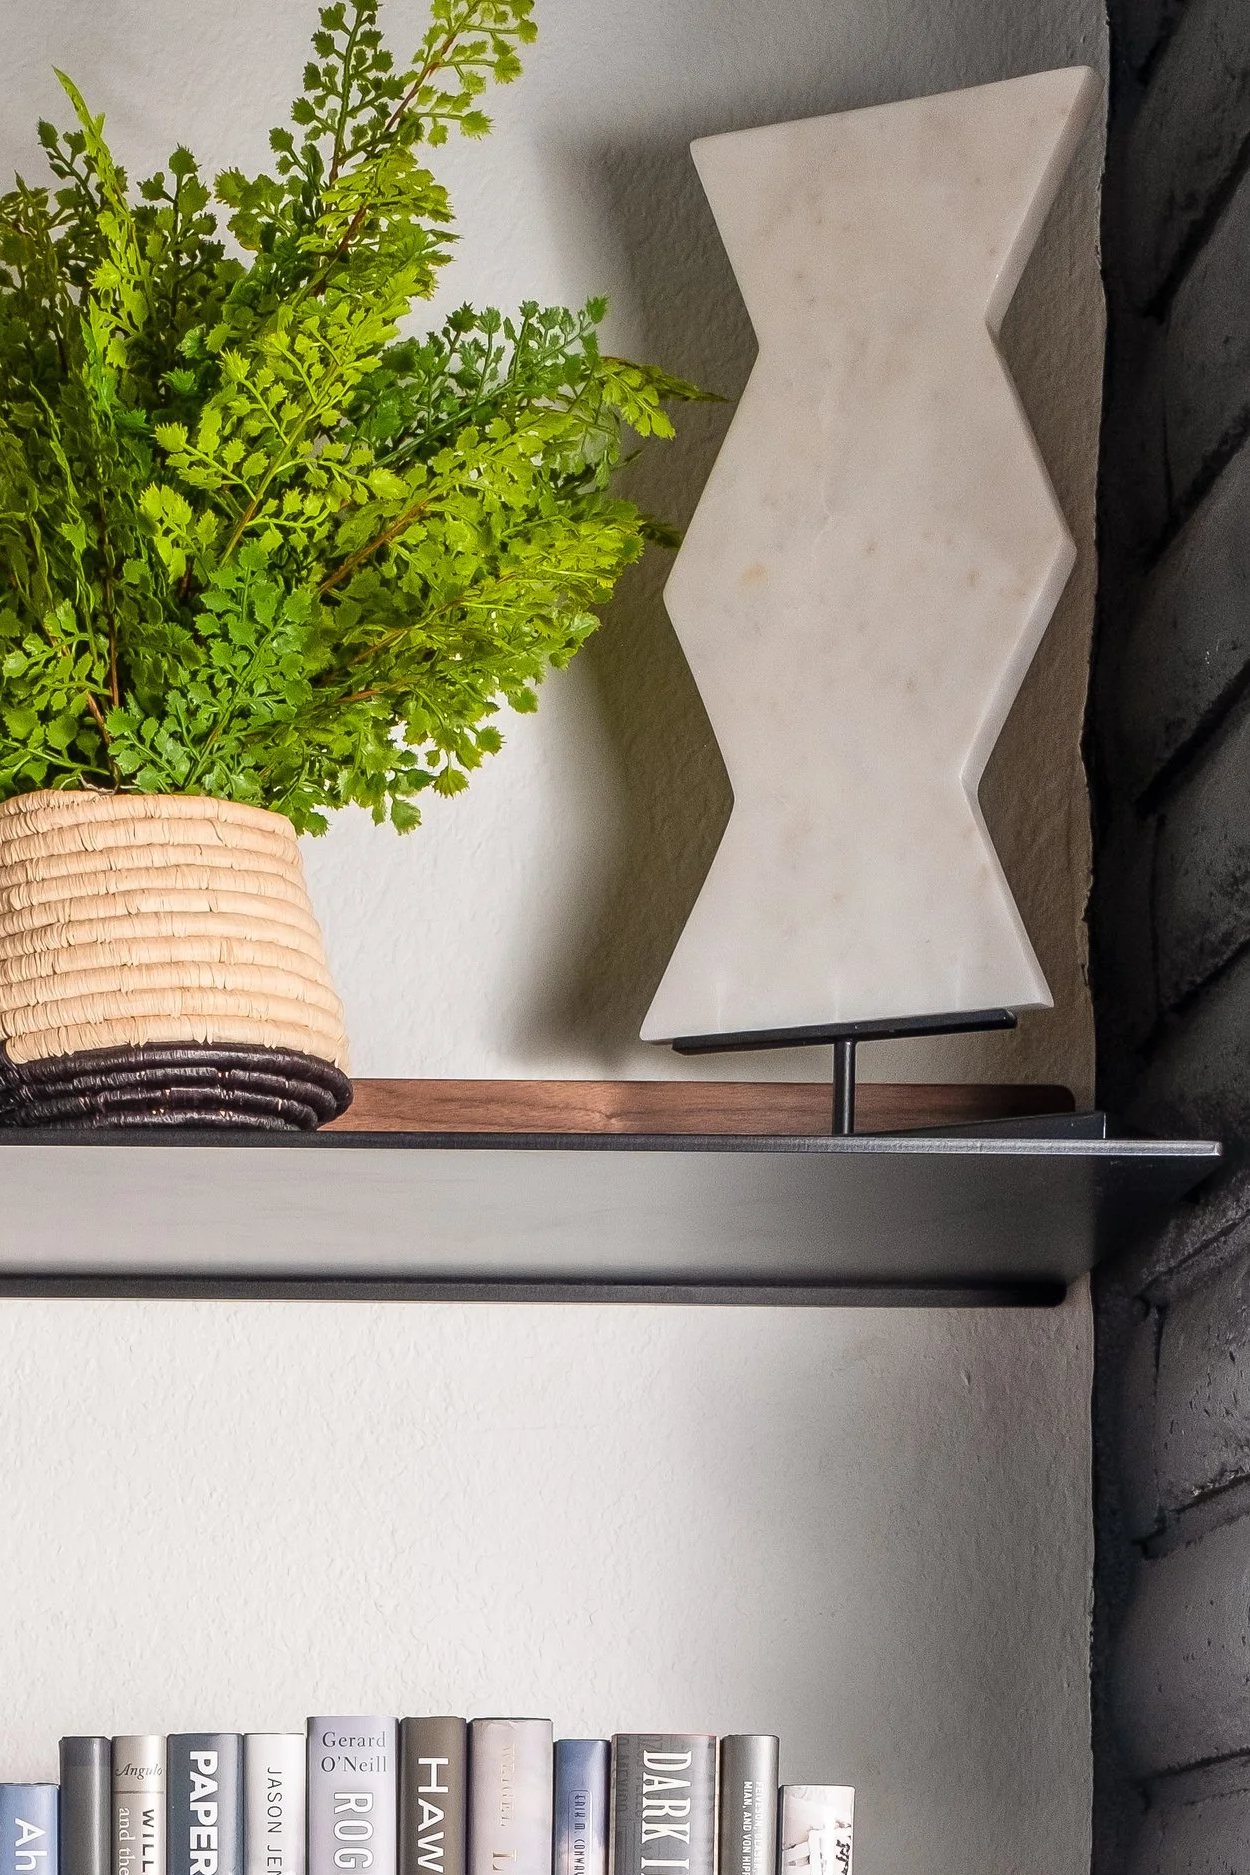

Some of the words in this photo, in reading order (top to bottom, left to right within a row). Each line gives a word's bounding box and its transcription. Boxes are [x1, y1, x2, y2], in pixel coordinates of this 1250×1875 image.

[321, 1731, 386, 1748] Gerard
[114, 1762, 163, 1780] Angulo
[266, 1767, 282, 1834] JASON
[640, 1750, 691, 1845] DARK
[742, 1781, 753, 1809] MIAN,
[118, 1806, 135, 1842] and
[190, 1750, 218, 1875] PAPER
[743, 1811, 752, 1831] AND
[742, 1833, 752, 1853] VON
[118, 1846, 135, 1875] the
